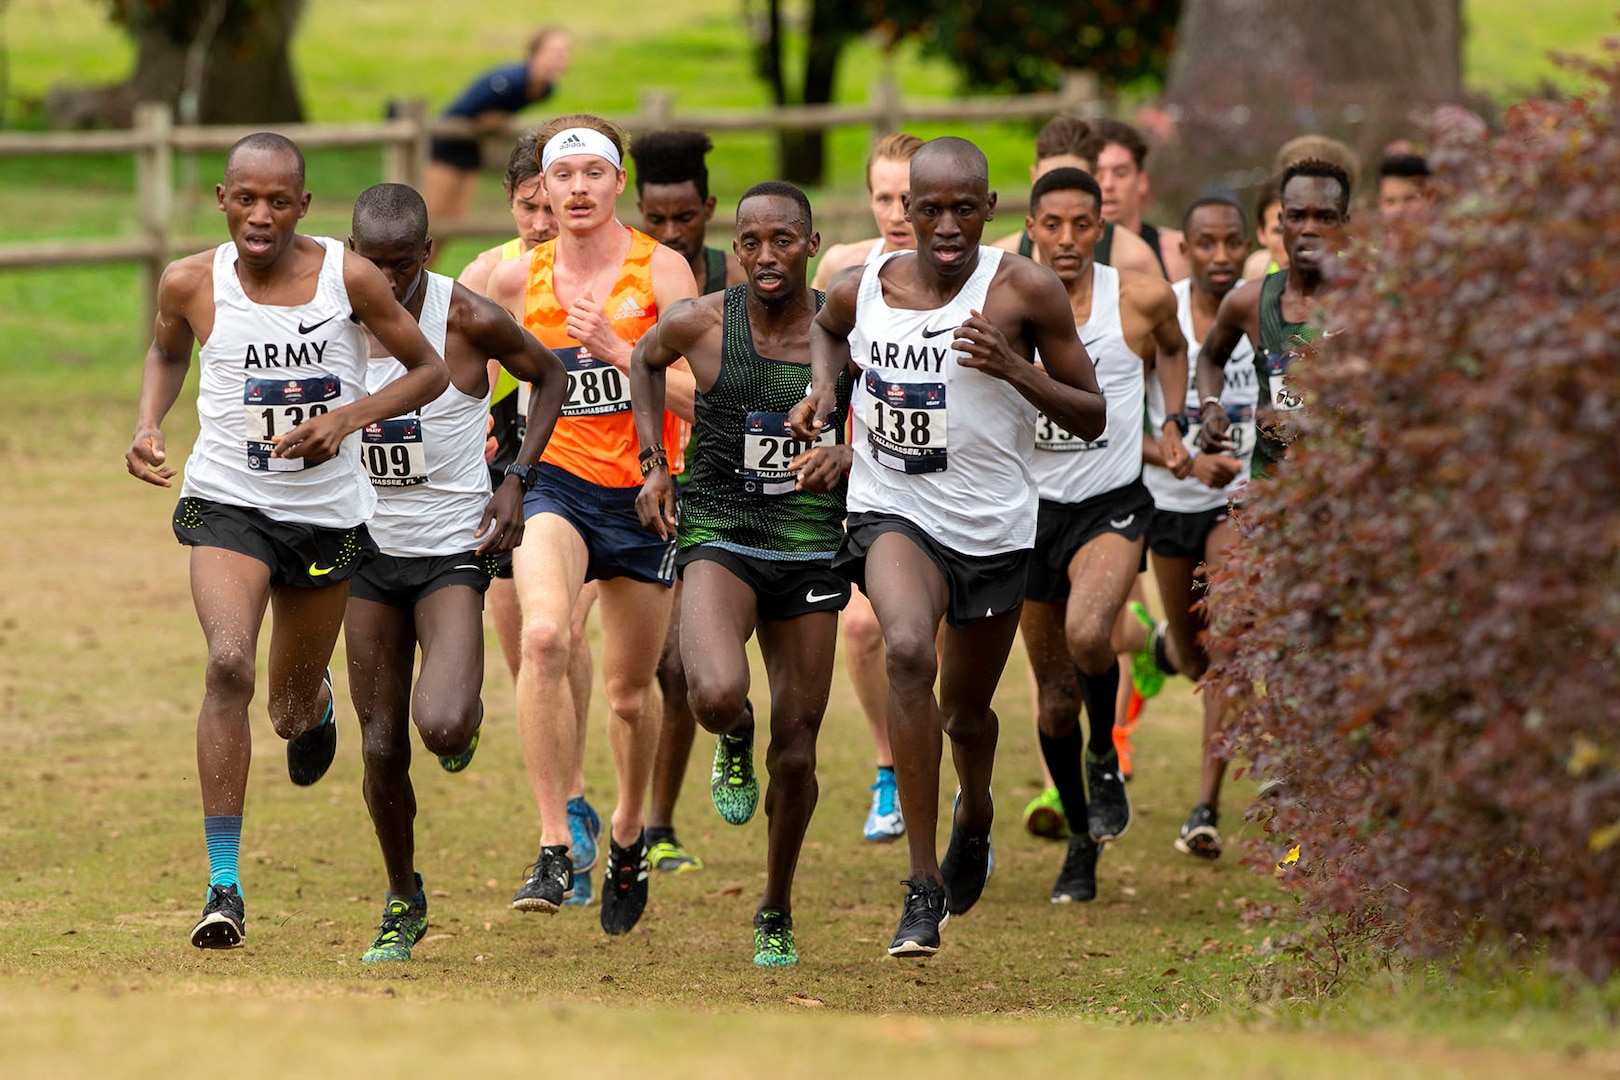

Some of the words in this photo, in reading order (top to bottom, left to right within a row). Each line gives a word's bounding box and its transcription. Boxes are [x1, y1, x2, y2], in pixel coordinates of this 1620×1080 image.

[560, 142, 586, 150] adidas
[244, 340, 328, 369] ARMY
[871, 341, 947, 373] ARMY
[564, 368, 622, 407] 280
[261, 404, 328, 441] 13
[563, 404, 617, 416] TALLAHASSEE,
[618, 402, 628, 410] FL
[875, 401, 930, 446] 138
[361, 444, 411, 477] 09
[758, 437, 822, 470] 29
[872, 434, 922, 456] TALLAHASSEE,
[371, 478, 405, 486] HASSEE,
